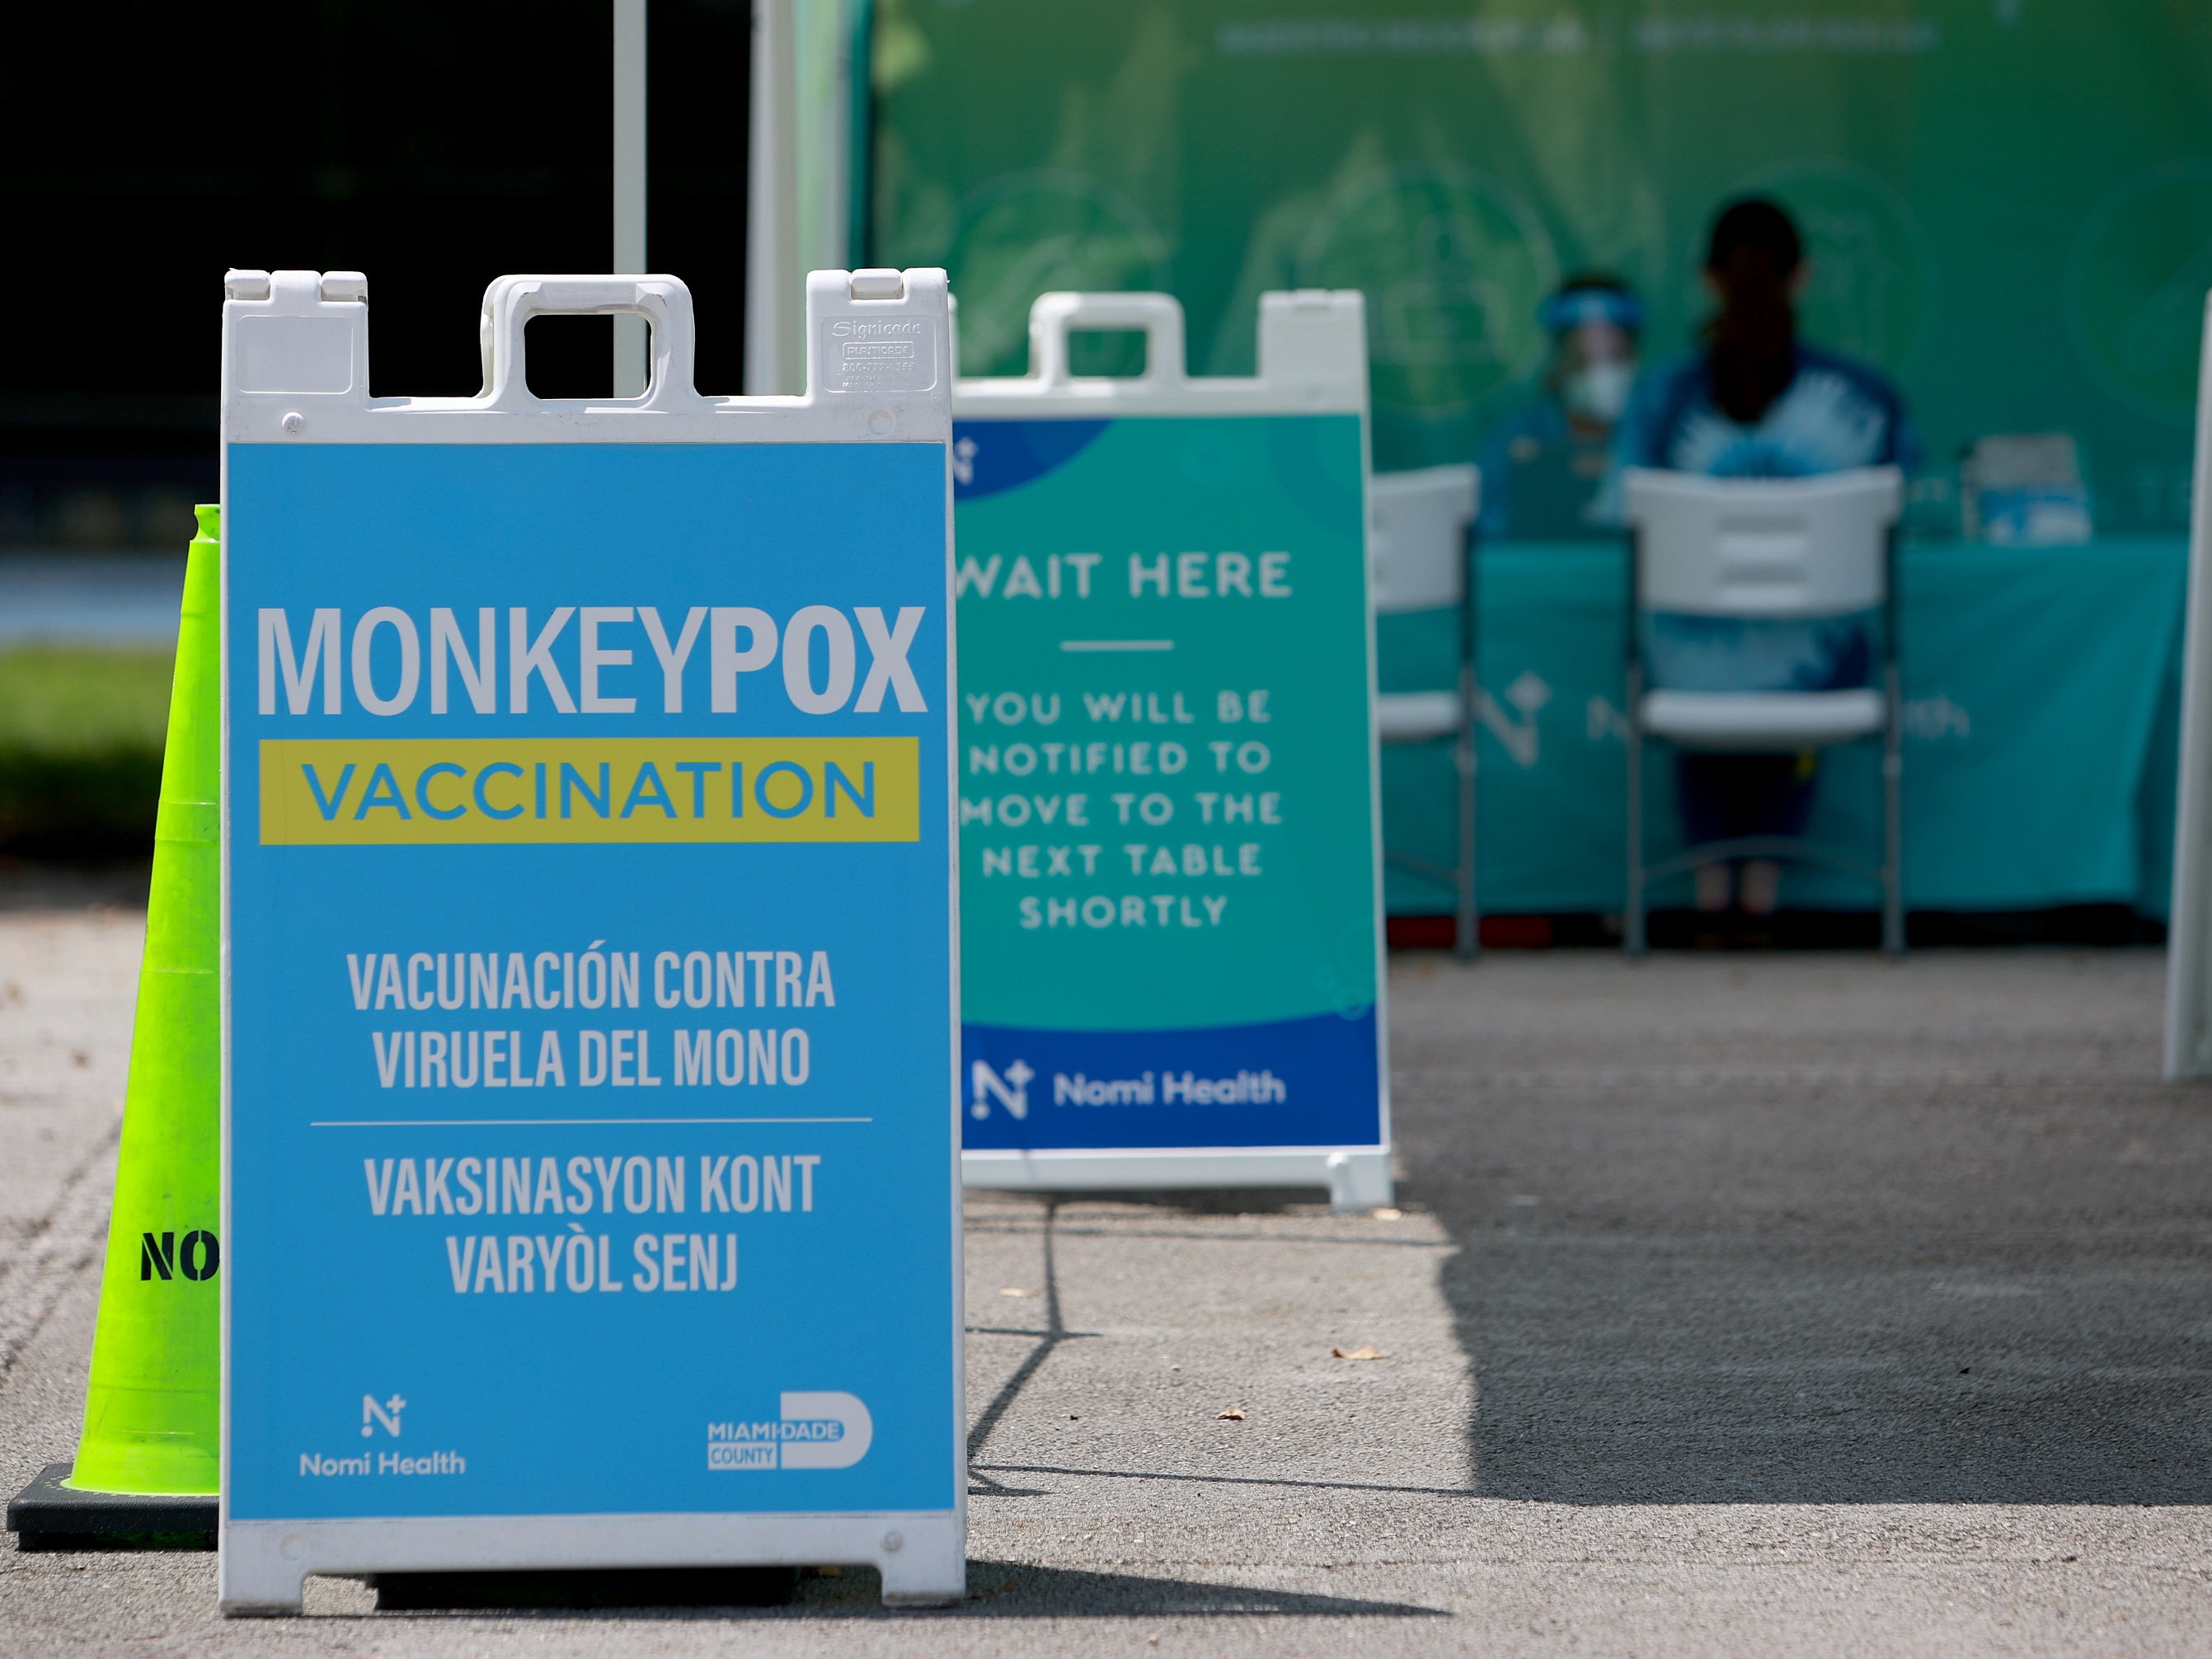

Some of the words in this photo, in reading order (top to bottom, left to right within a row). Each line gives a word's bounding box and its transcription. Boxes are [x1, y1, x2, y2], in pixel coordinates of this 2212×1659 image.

[831, 319, 922, 340] Signicade
[847, 345, 909, 355] PLASTICADE
[956, 553, 1102, 599] WAIT
[1129, 552, 1293, 599] HERE
[257, 604, 929, 717] MONKEYPOX
[965, 691, 1062, 726] YOU
[1083, 692, 1195, 724] WILL
[1217, 689, 1271, 723] BE
[970, 741, 1188, 776] NOTIFIED
[1209, 740, 1271, 775] TO
[302, 760, 875, 820] VACCINATION
[959, 793, 1090, 827] MOVE
[1111, 792, 1174, 826] TO
[1195, 792, 1283, 825] THE
[982, 844, 1102, 878] NEXT
[1124, 843, 1263, 876] TABLE
[1019, 895, 1228, 929] SHORTLY
[346, 939, 640, 1011] VACUNACIÓN
[654, 951, 836, 1008] CONTRA
[372, 1029, 566, 1088] VIRUELA
[579, 1029, 662, 1087] DEL
[674, 1028, 810, 1087] MONO
[1054, 1071, 1155, 1106] Nomi
[1162, 1069, 1287, 1105] Health
[364, 1155, 685, 1216] VAKSINASYON
[700, 1154, 821, 1214] KONT
[445, 1223, 623, 1294] VARYÒL
[632, 1234, 738, 1293] SENJ
[299, 1451, 371, 1477] Nomi
[378, 1449, 466, 1475] Health
[711, 1447, 773, 1464] COUNTY
